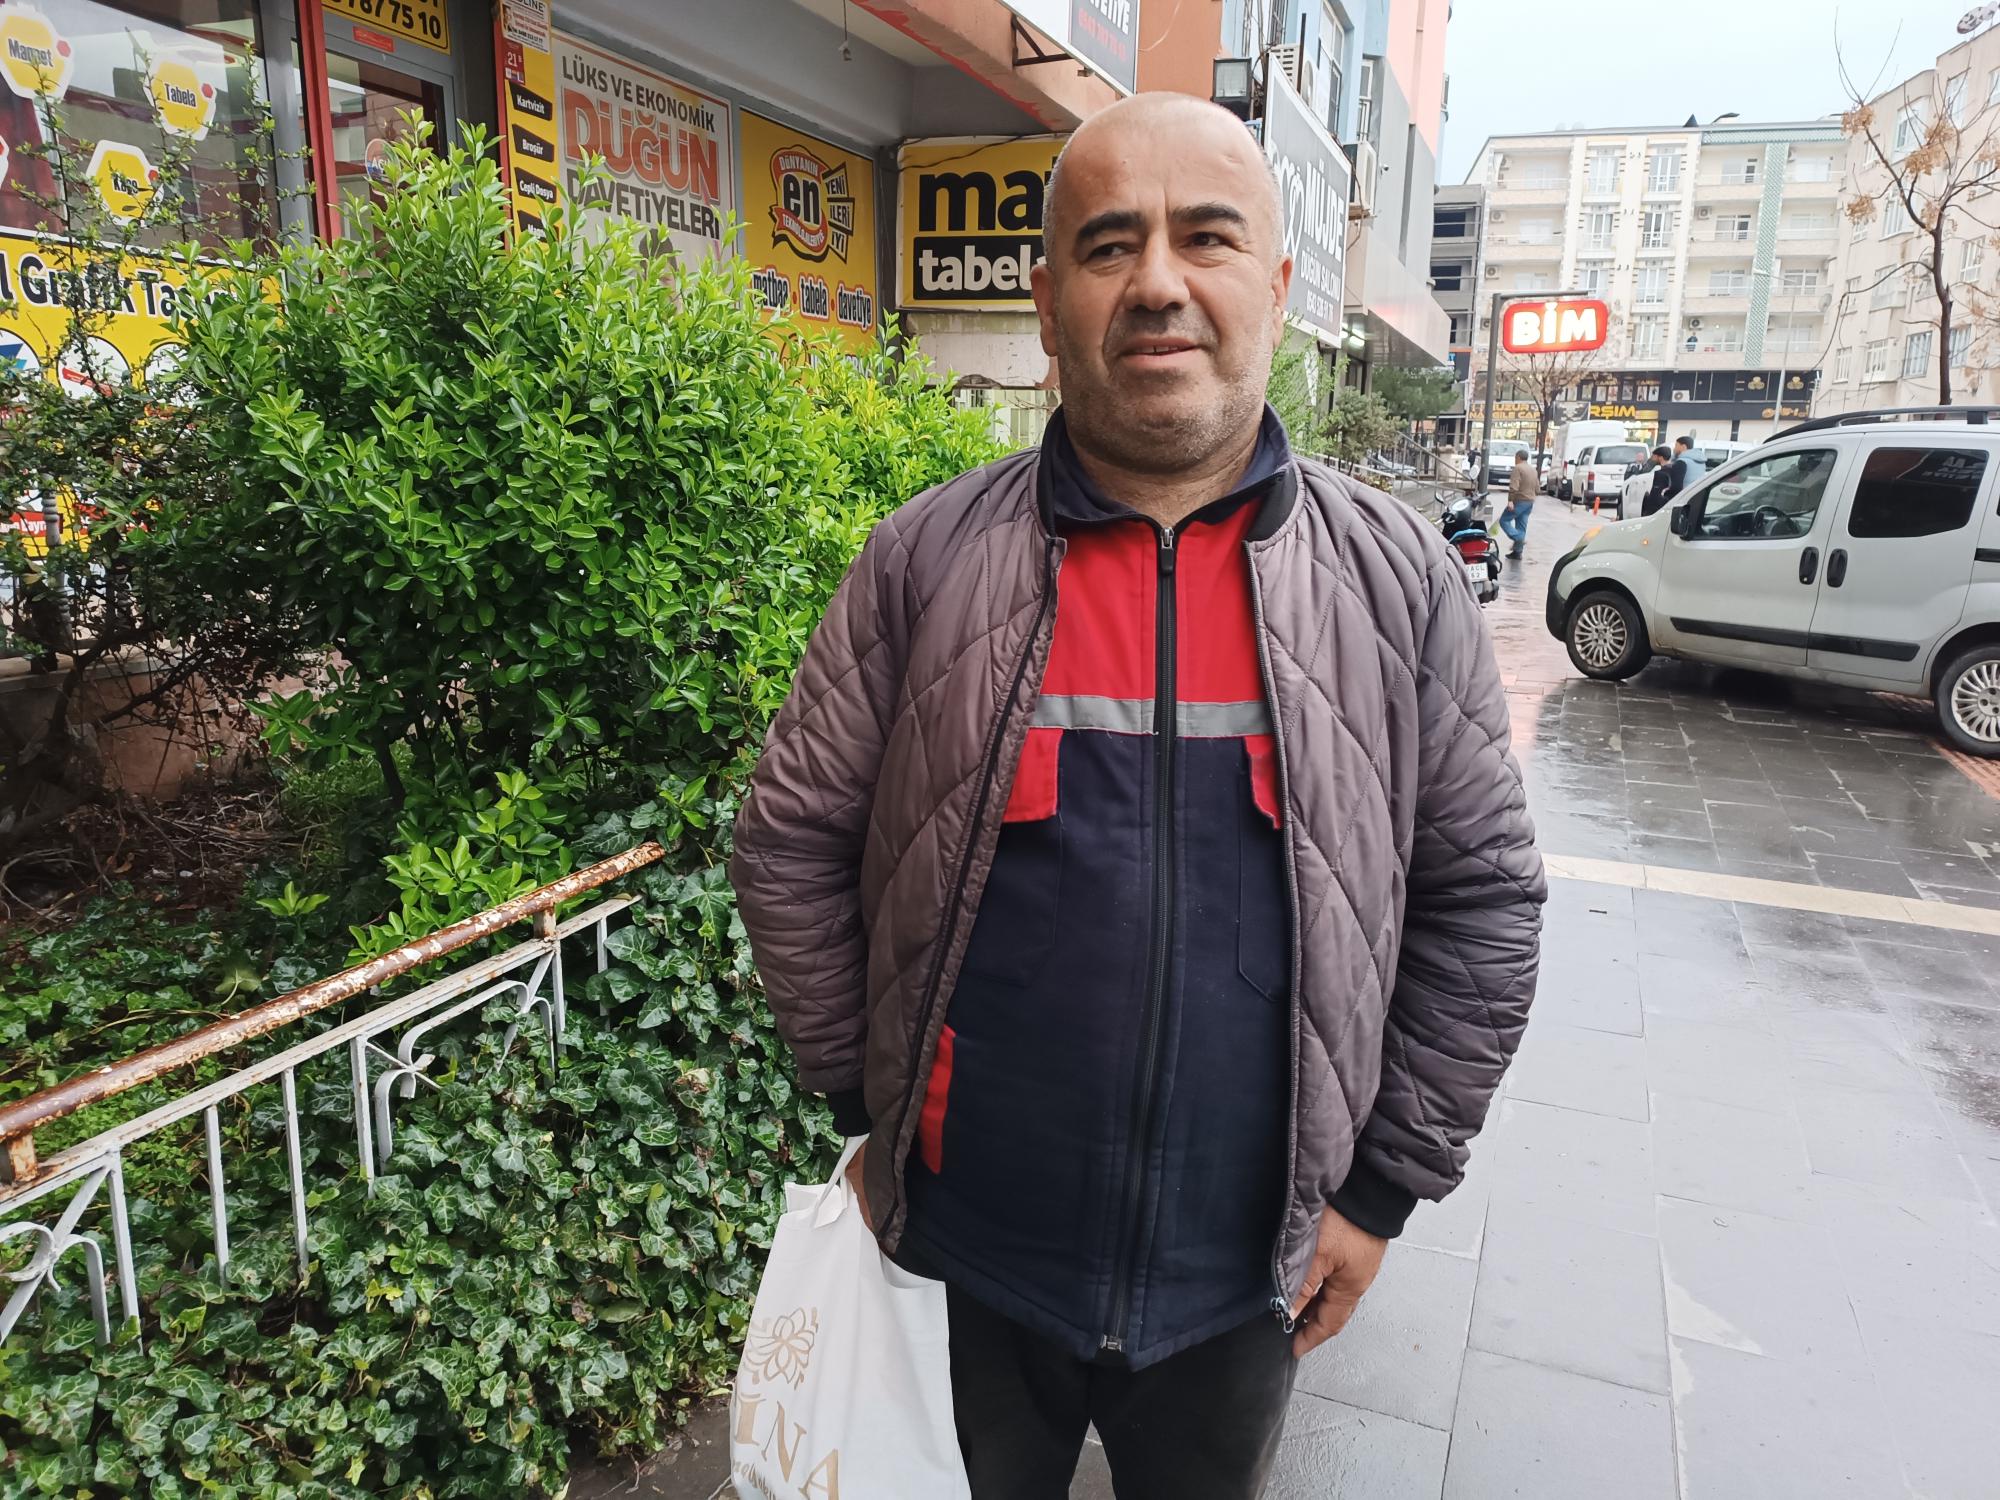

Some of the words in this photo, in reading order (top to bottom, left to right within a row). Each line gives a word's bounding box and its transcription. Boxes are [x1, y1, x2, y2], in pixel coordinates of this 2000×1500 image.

[389, 0, 413, 29] 75
[418, 12, 441, 39] 10
[164, 83, 196, 107] Tabela
[517, 95, 544, 114] Kartvizit
[563, 55, 607, 92] LÜKS
[611, 75, 633, 101] VE
[636, 84, 715, 132] EKONOMİK
[522, 139, 544, 156] Broşür
[563, 88, 720, 202] DÜĞÜN
[519, 180, 535, 195] Cepli
[535, 184, 553, 199] Dosya
[783, 173, 820, 225] en
[825, 175, 846, 195] YENİ
[830, 204, 850, 228] İLERİ
[1304, 158, 1344, 262] MÜJDE
[832, 231, 845, 253] İYİ
[919, 245, 1045, 292] tabel
[1300, 246, 1321, 288] DÜĞÜN
[753, 270, 788, 309] matbaa
[801, 277, 828, 316] tabela
[838, 284, 872, 328] davetiye
[1512, 302, 1597, 345] BİM
